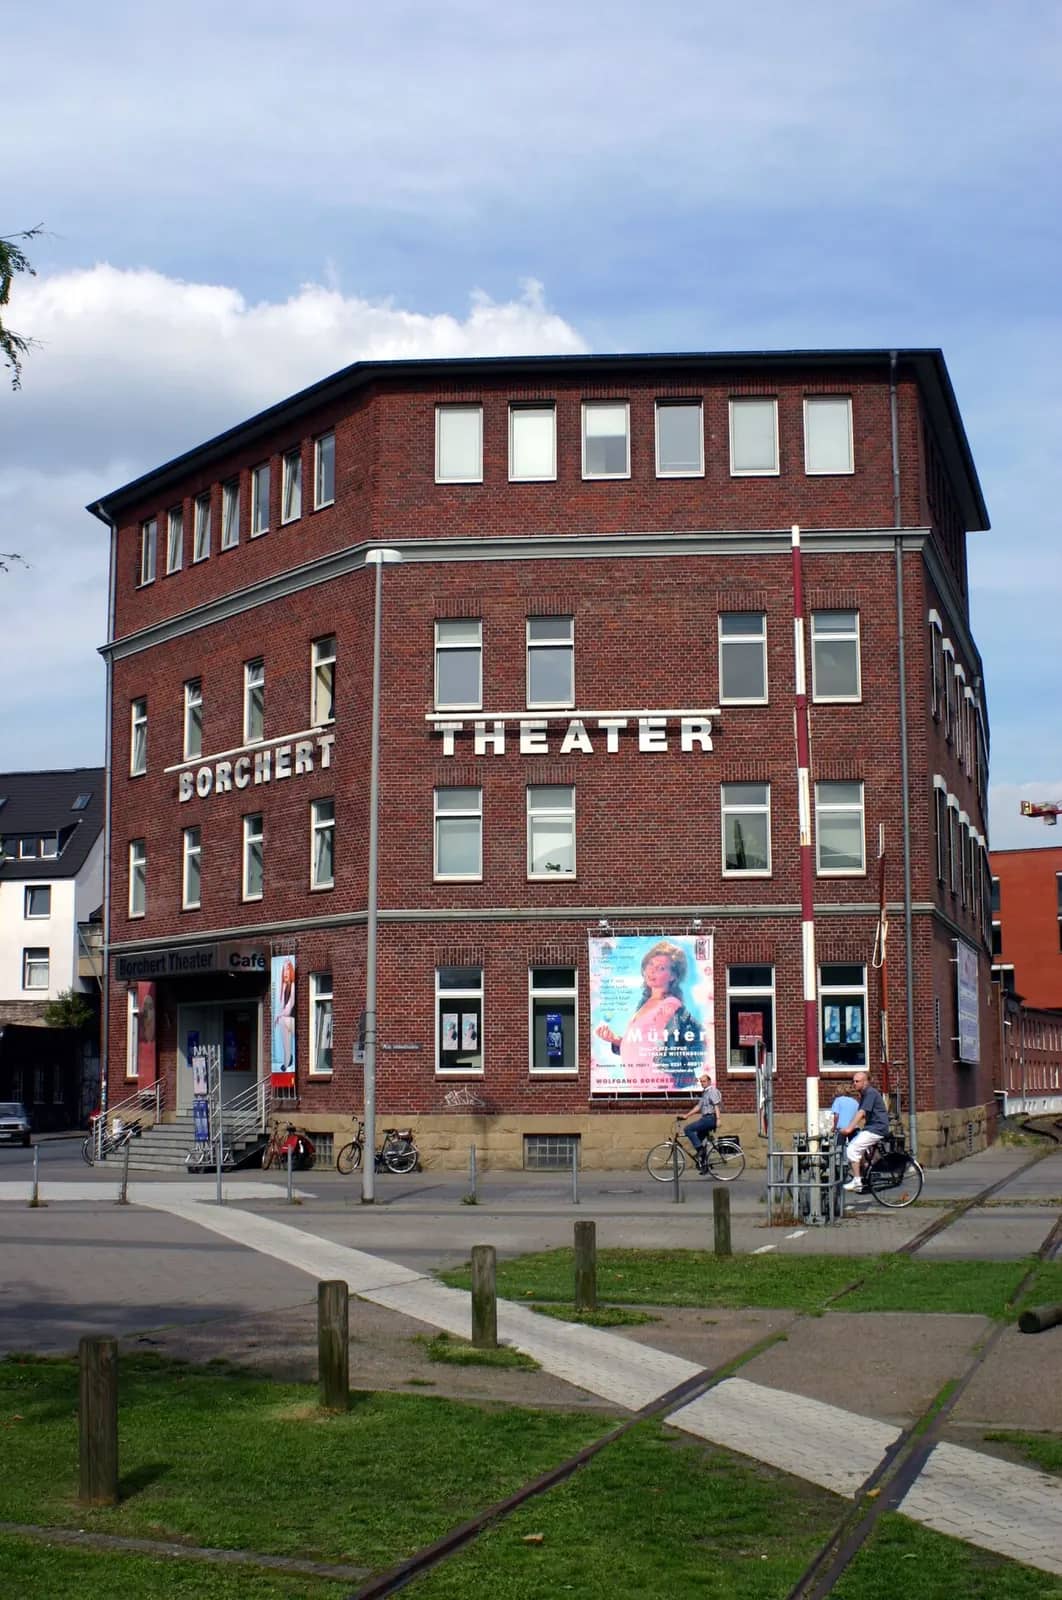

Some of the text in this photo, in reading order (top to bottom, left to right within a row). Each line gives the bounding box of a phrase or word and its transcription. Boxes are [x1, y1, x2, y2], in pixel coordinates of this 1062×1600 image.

[434, 718, 714, 756] THEATER
[178, 734, 335, 803] BORCHERT
[119, 952, 214, 976] Borchert Theater
[229, 952, 266, 968] Café
[628, 1027, 707, 1042] Mütter
